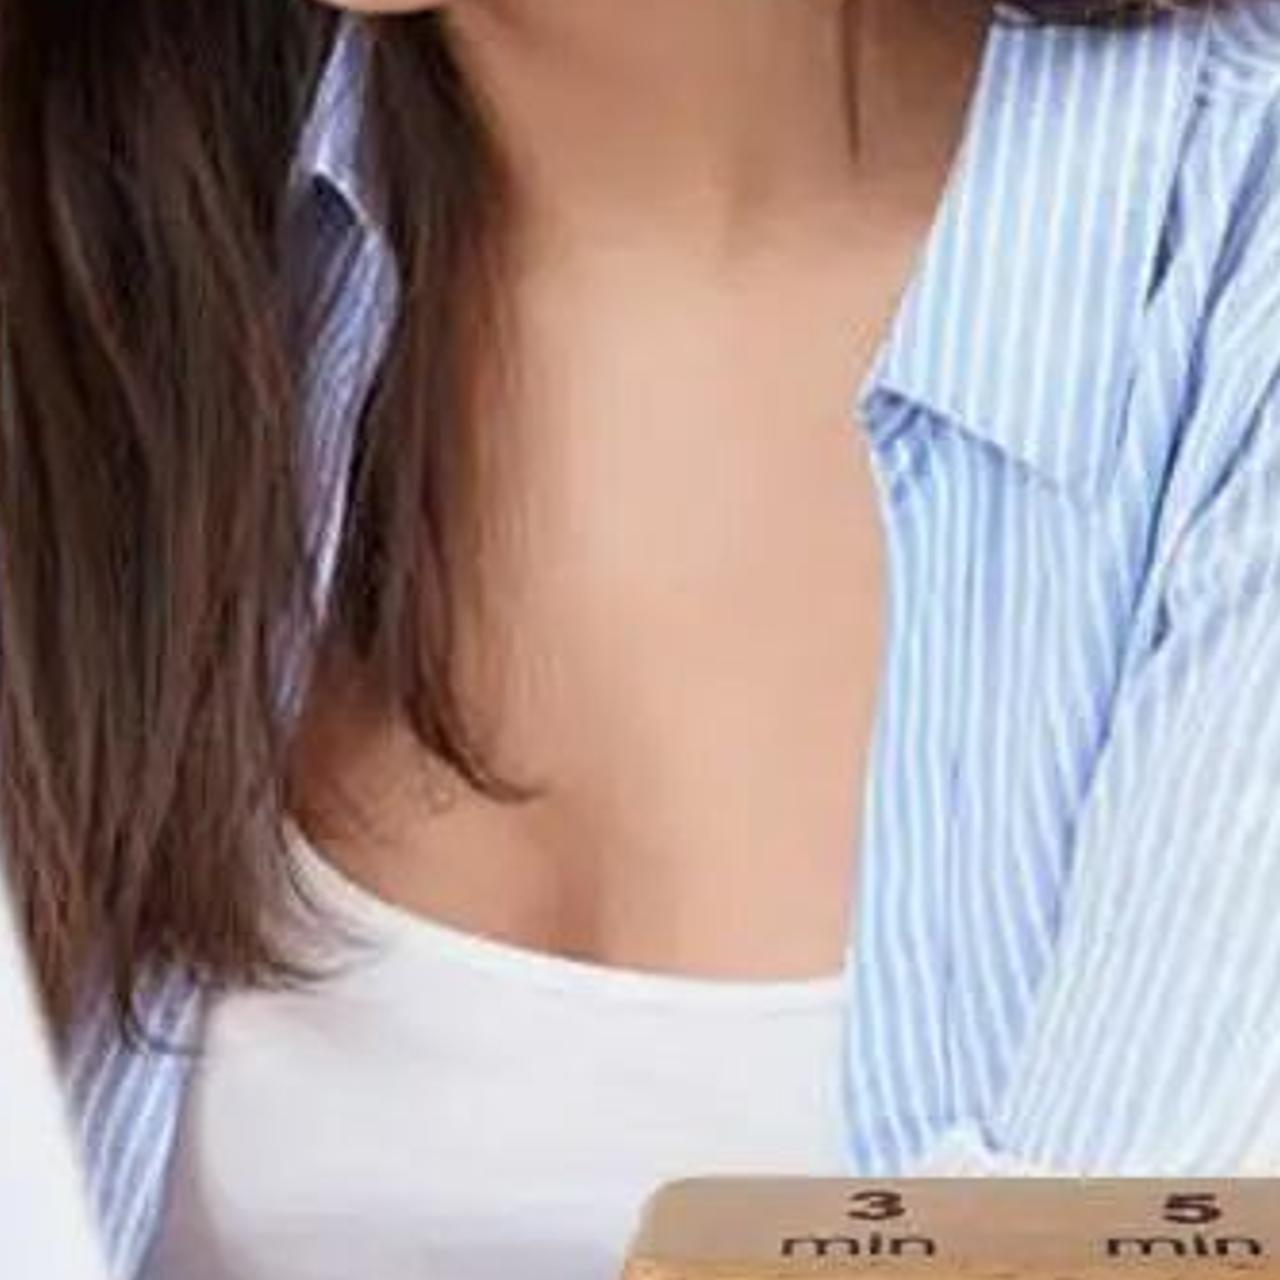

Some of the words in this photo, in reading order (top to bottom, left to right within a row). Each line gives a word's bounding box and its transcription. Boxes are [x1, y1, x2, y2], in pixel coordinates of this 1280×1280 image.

[847, 1191, 907, 1222] 3
[1162, 1192, 1224, 1225] 5
[781, 1232, 938, 1257] min
[1105, 1233, 1264, 1259] min
